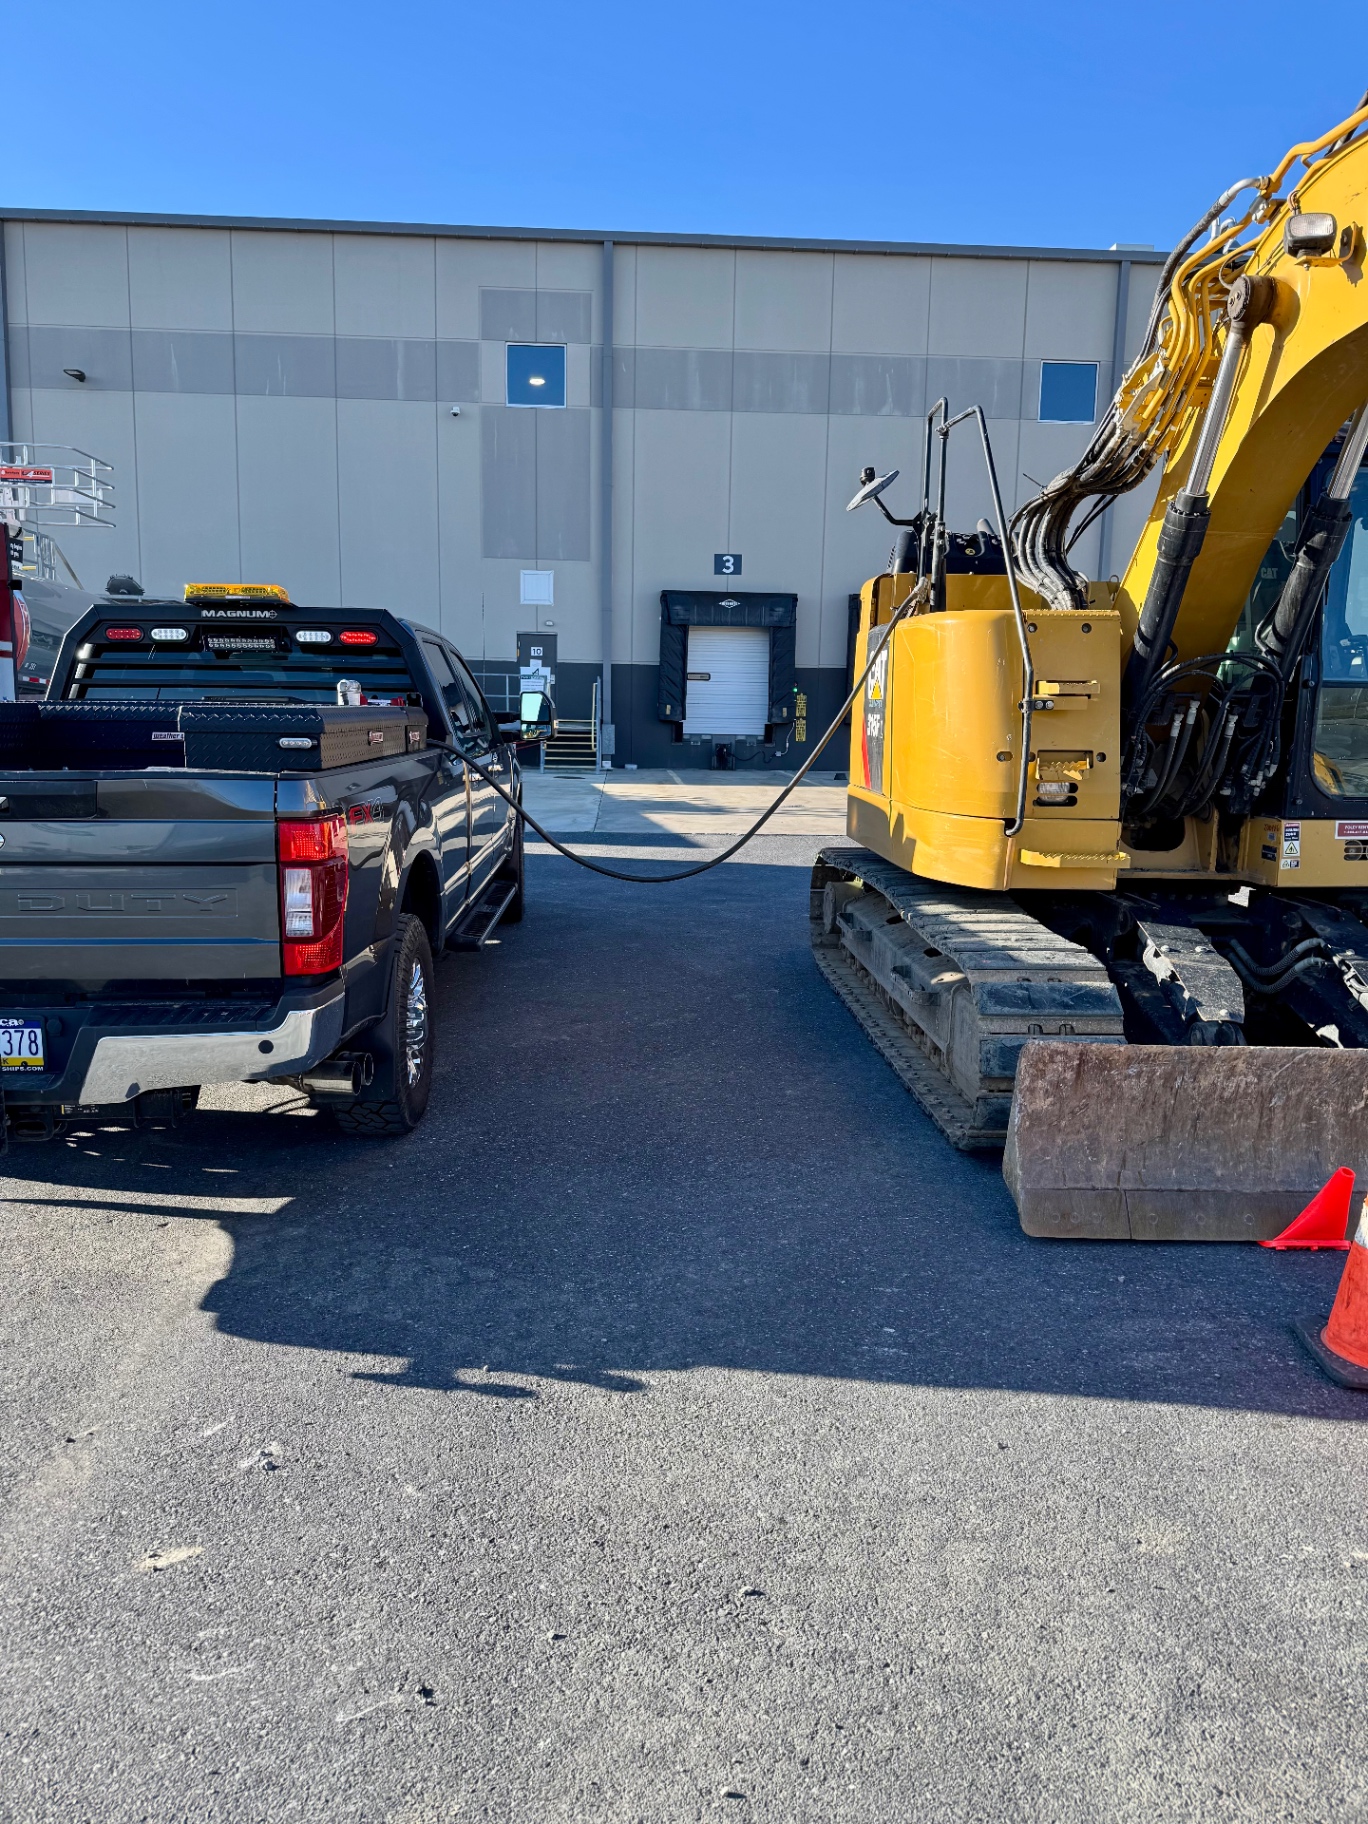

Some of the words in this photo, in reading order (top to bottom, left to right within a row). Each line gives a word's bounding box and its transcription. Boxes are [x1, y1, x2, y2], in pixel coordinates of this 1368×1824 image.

[722, 555, 734, 574] 3
[1261, 567, 1278, 579] CAT
[201, 610, 269, 618] MAGNUM
[348, 797, 385, 825] FX4
[17, 893, 229, 912] DUTY
[1, 1030, 39, 1056] 378
